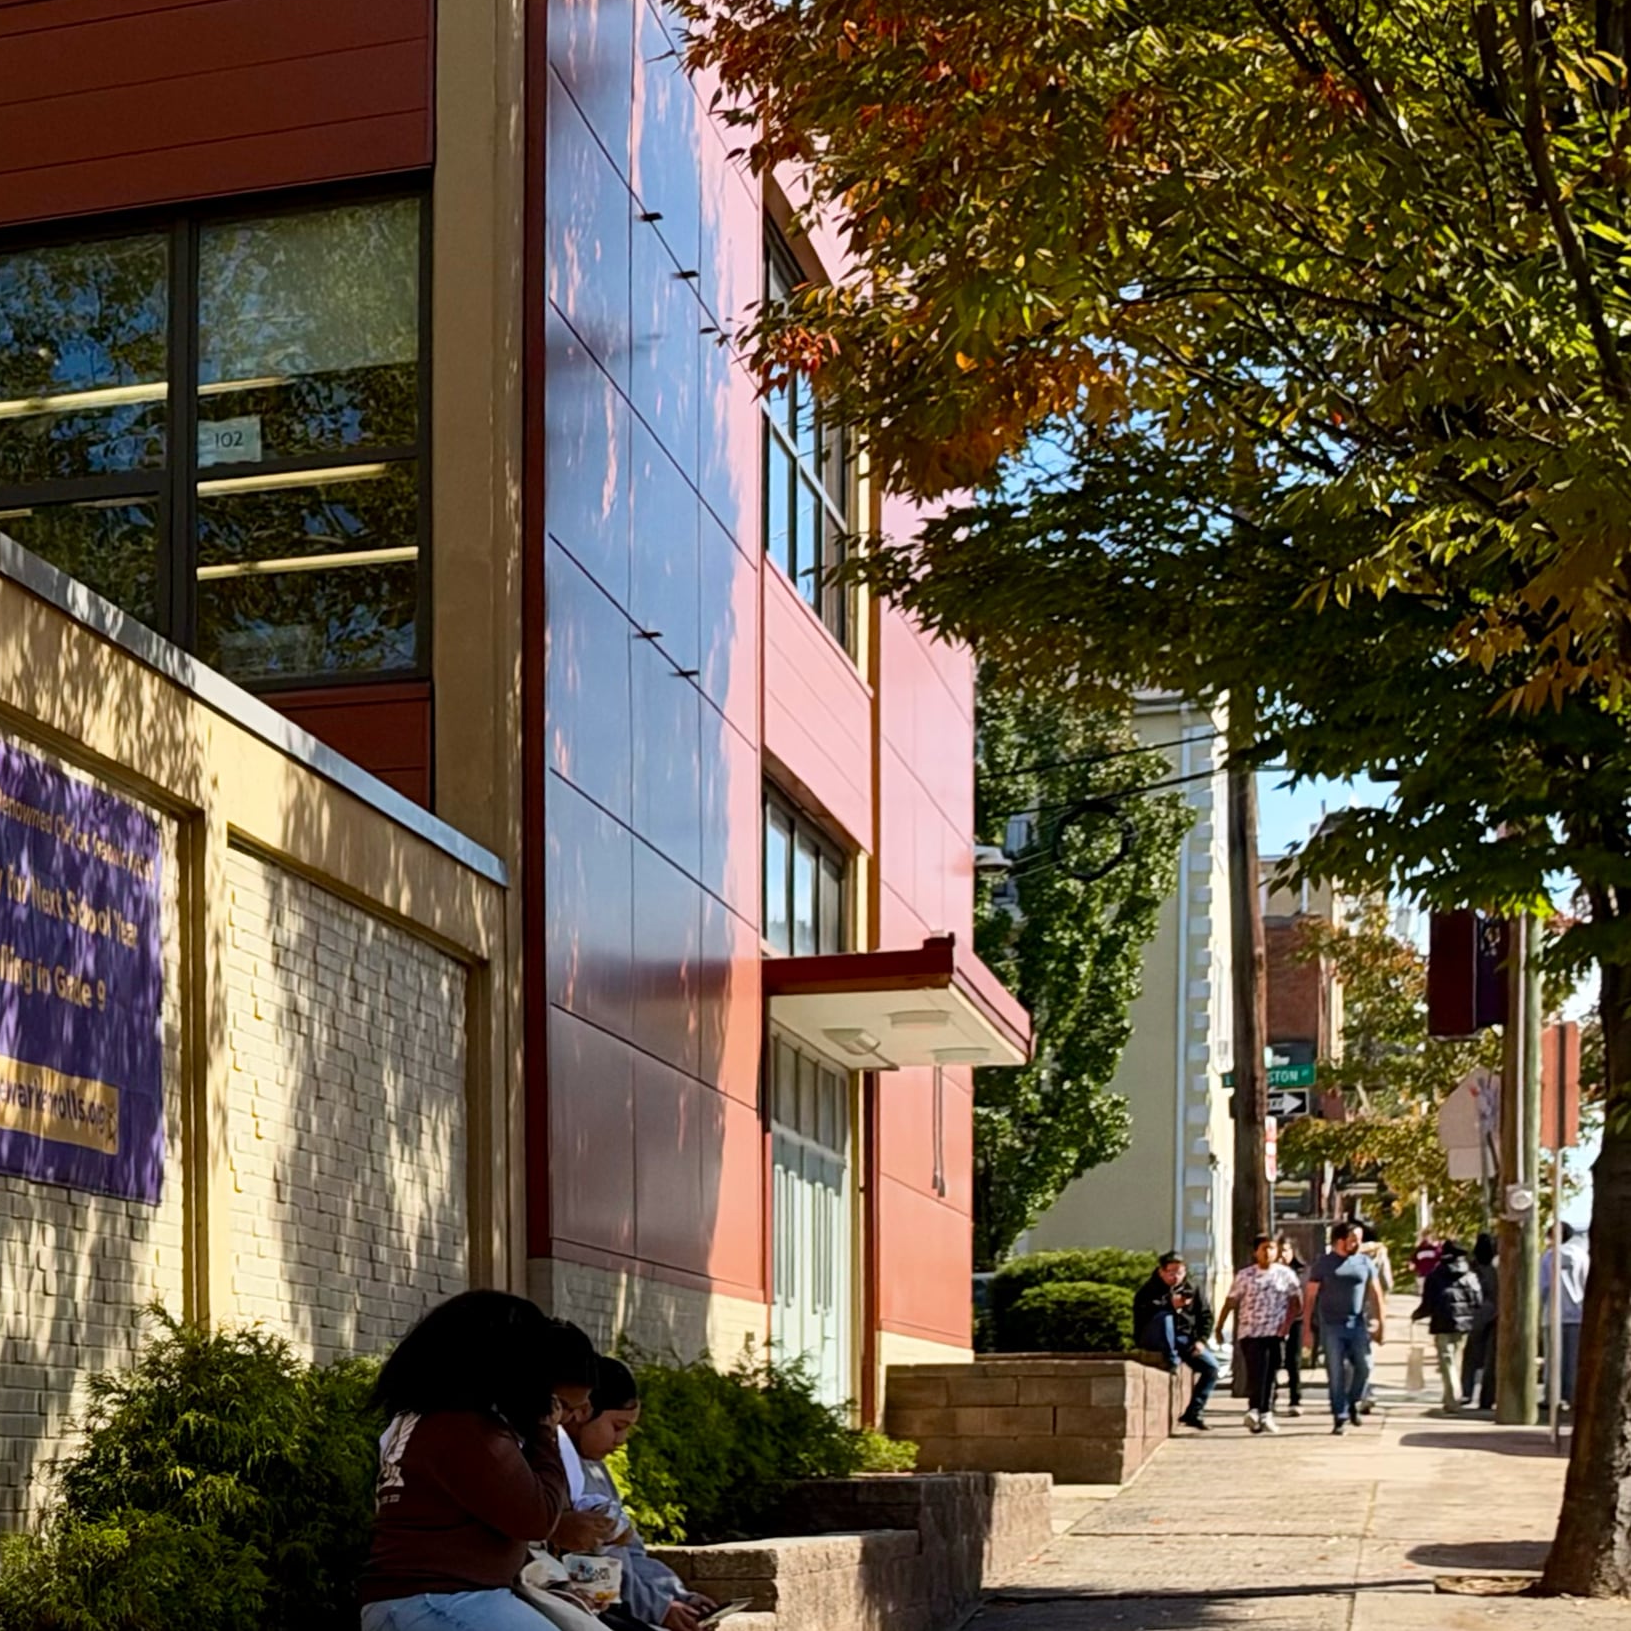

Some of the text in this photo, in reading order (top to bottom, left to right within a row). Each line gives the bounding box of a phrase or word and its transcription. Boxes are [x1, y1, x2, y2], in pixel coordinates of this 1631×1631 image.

[214, 431, 244, 449] 102
[30, 874, 64, 921] Next
[66, 888, 111, 940] School
[37, 957, 51, 995] in
[96, 978, 107, 1012] 9
